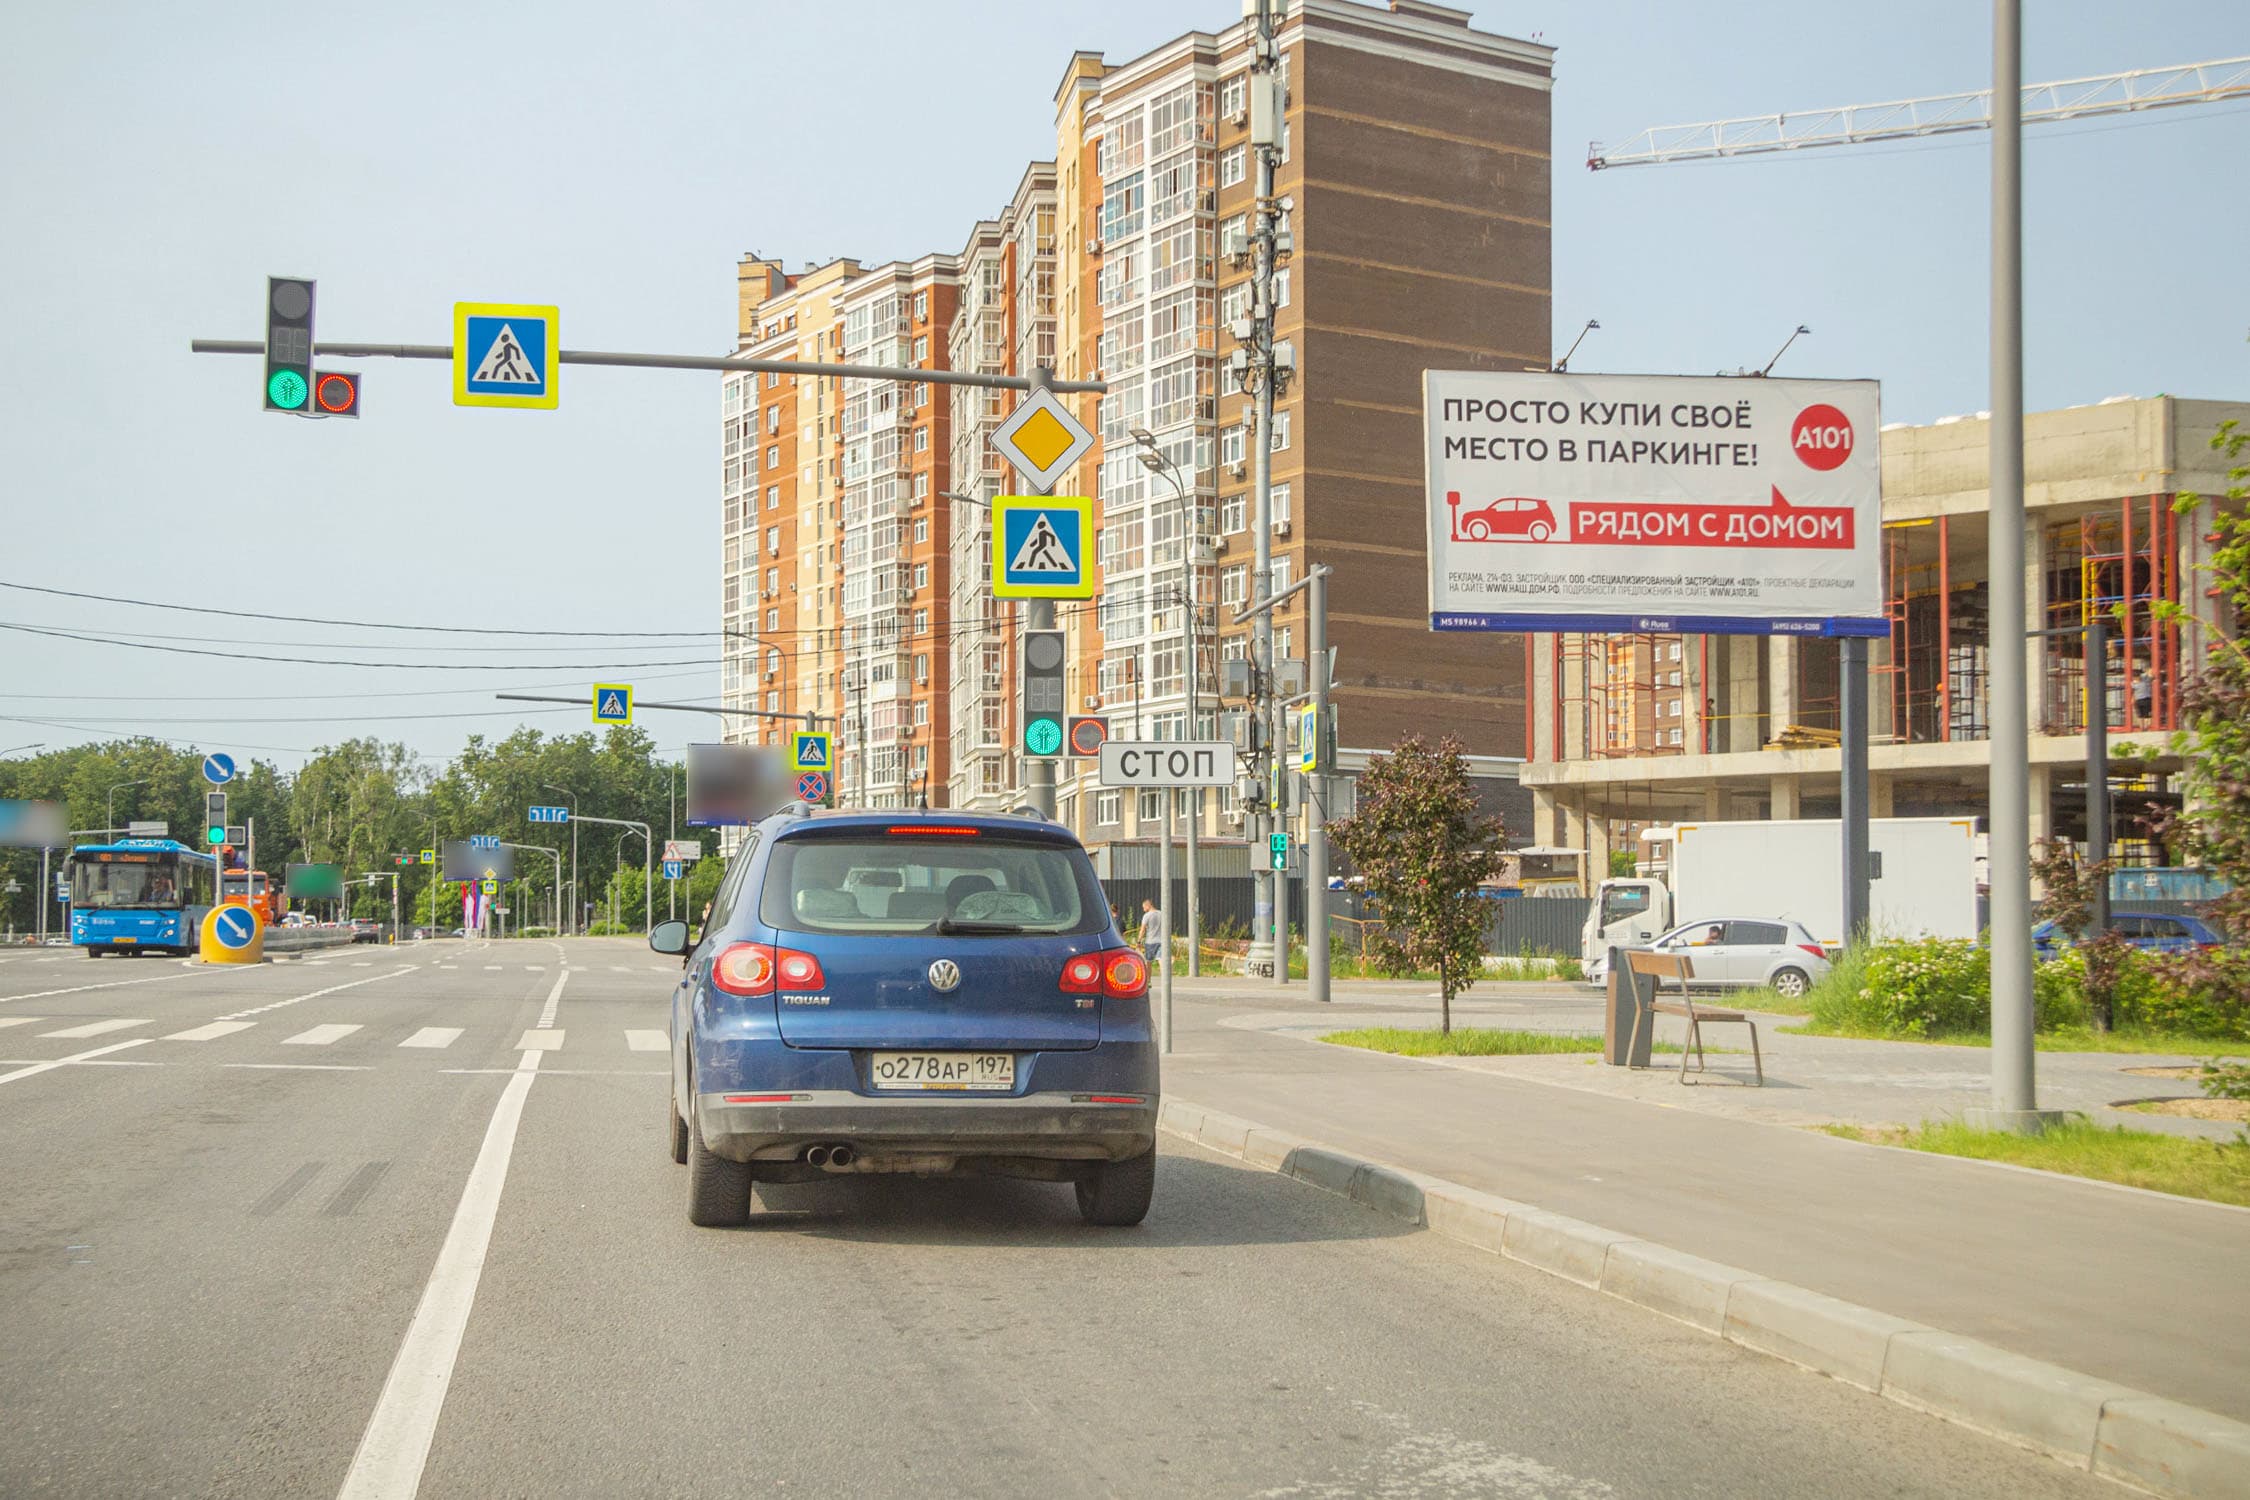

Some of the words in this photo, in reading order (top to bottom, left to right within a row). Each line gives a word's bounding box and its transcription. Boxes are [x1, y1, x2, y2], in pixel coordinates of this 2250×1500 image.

[1443, 398, 1570, 424] ПРОСТО
[1580, 402, 1661, 427] КУПИ
[1670, 400, 1752, 429] СВОЁ
[1795, 426, 1851, 449] А101
[1444, 436, 1548, 461] МЕСТО
[1559, 439, 1578, 462] В
[1587, 440, 1757, 467] ПАРКИНГЕ!
[1578, 510, 1690, 540] РЯДОМ
[1698, 512, 1718, 537] С
[1724, 513, 1843, 542] ДОМОМ
[1449, 583, 1459, 593] НА
[1461, 582, 1485, 593] САЙТЕ
[1563, 584, 1616, 595] ПОДРОБНОСТИ
[1617, 585, 1672, 596] ПРЕДЛОЖЕНИЯ
[1674, 586, 1684, 596] НА
[1685, 586, 1708, 597] САЙТЕ
[1568, 574, 1585, 584] ООО
[1587, 574, 1683, 586] «СПЕЦИАЛИЗИРОВАННЫЙ
[1684, 575, 1735, 587] ЗАСТРОЙЩИК
[1808, 578, 1855, 589] ДЕКЛАРАЦИИ
[1120, 750, 1214, 778] СТОП
[782, 995, 831, 1006] TIGUAN
[881, 1056, 970, 1079] О278АР
[976, 1056, 1007, 1074] 197
